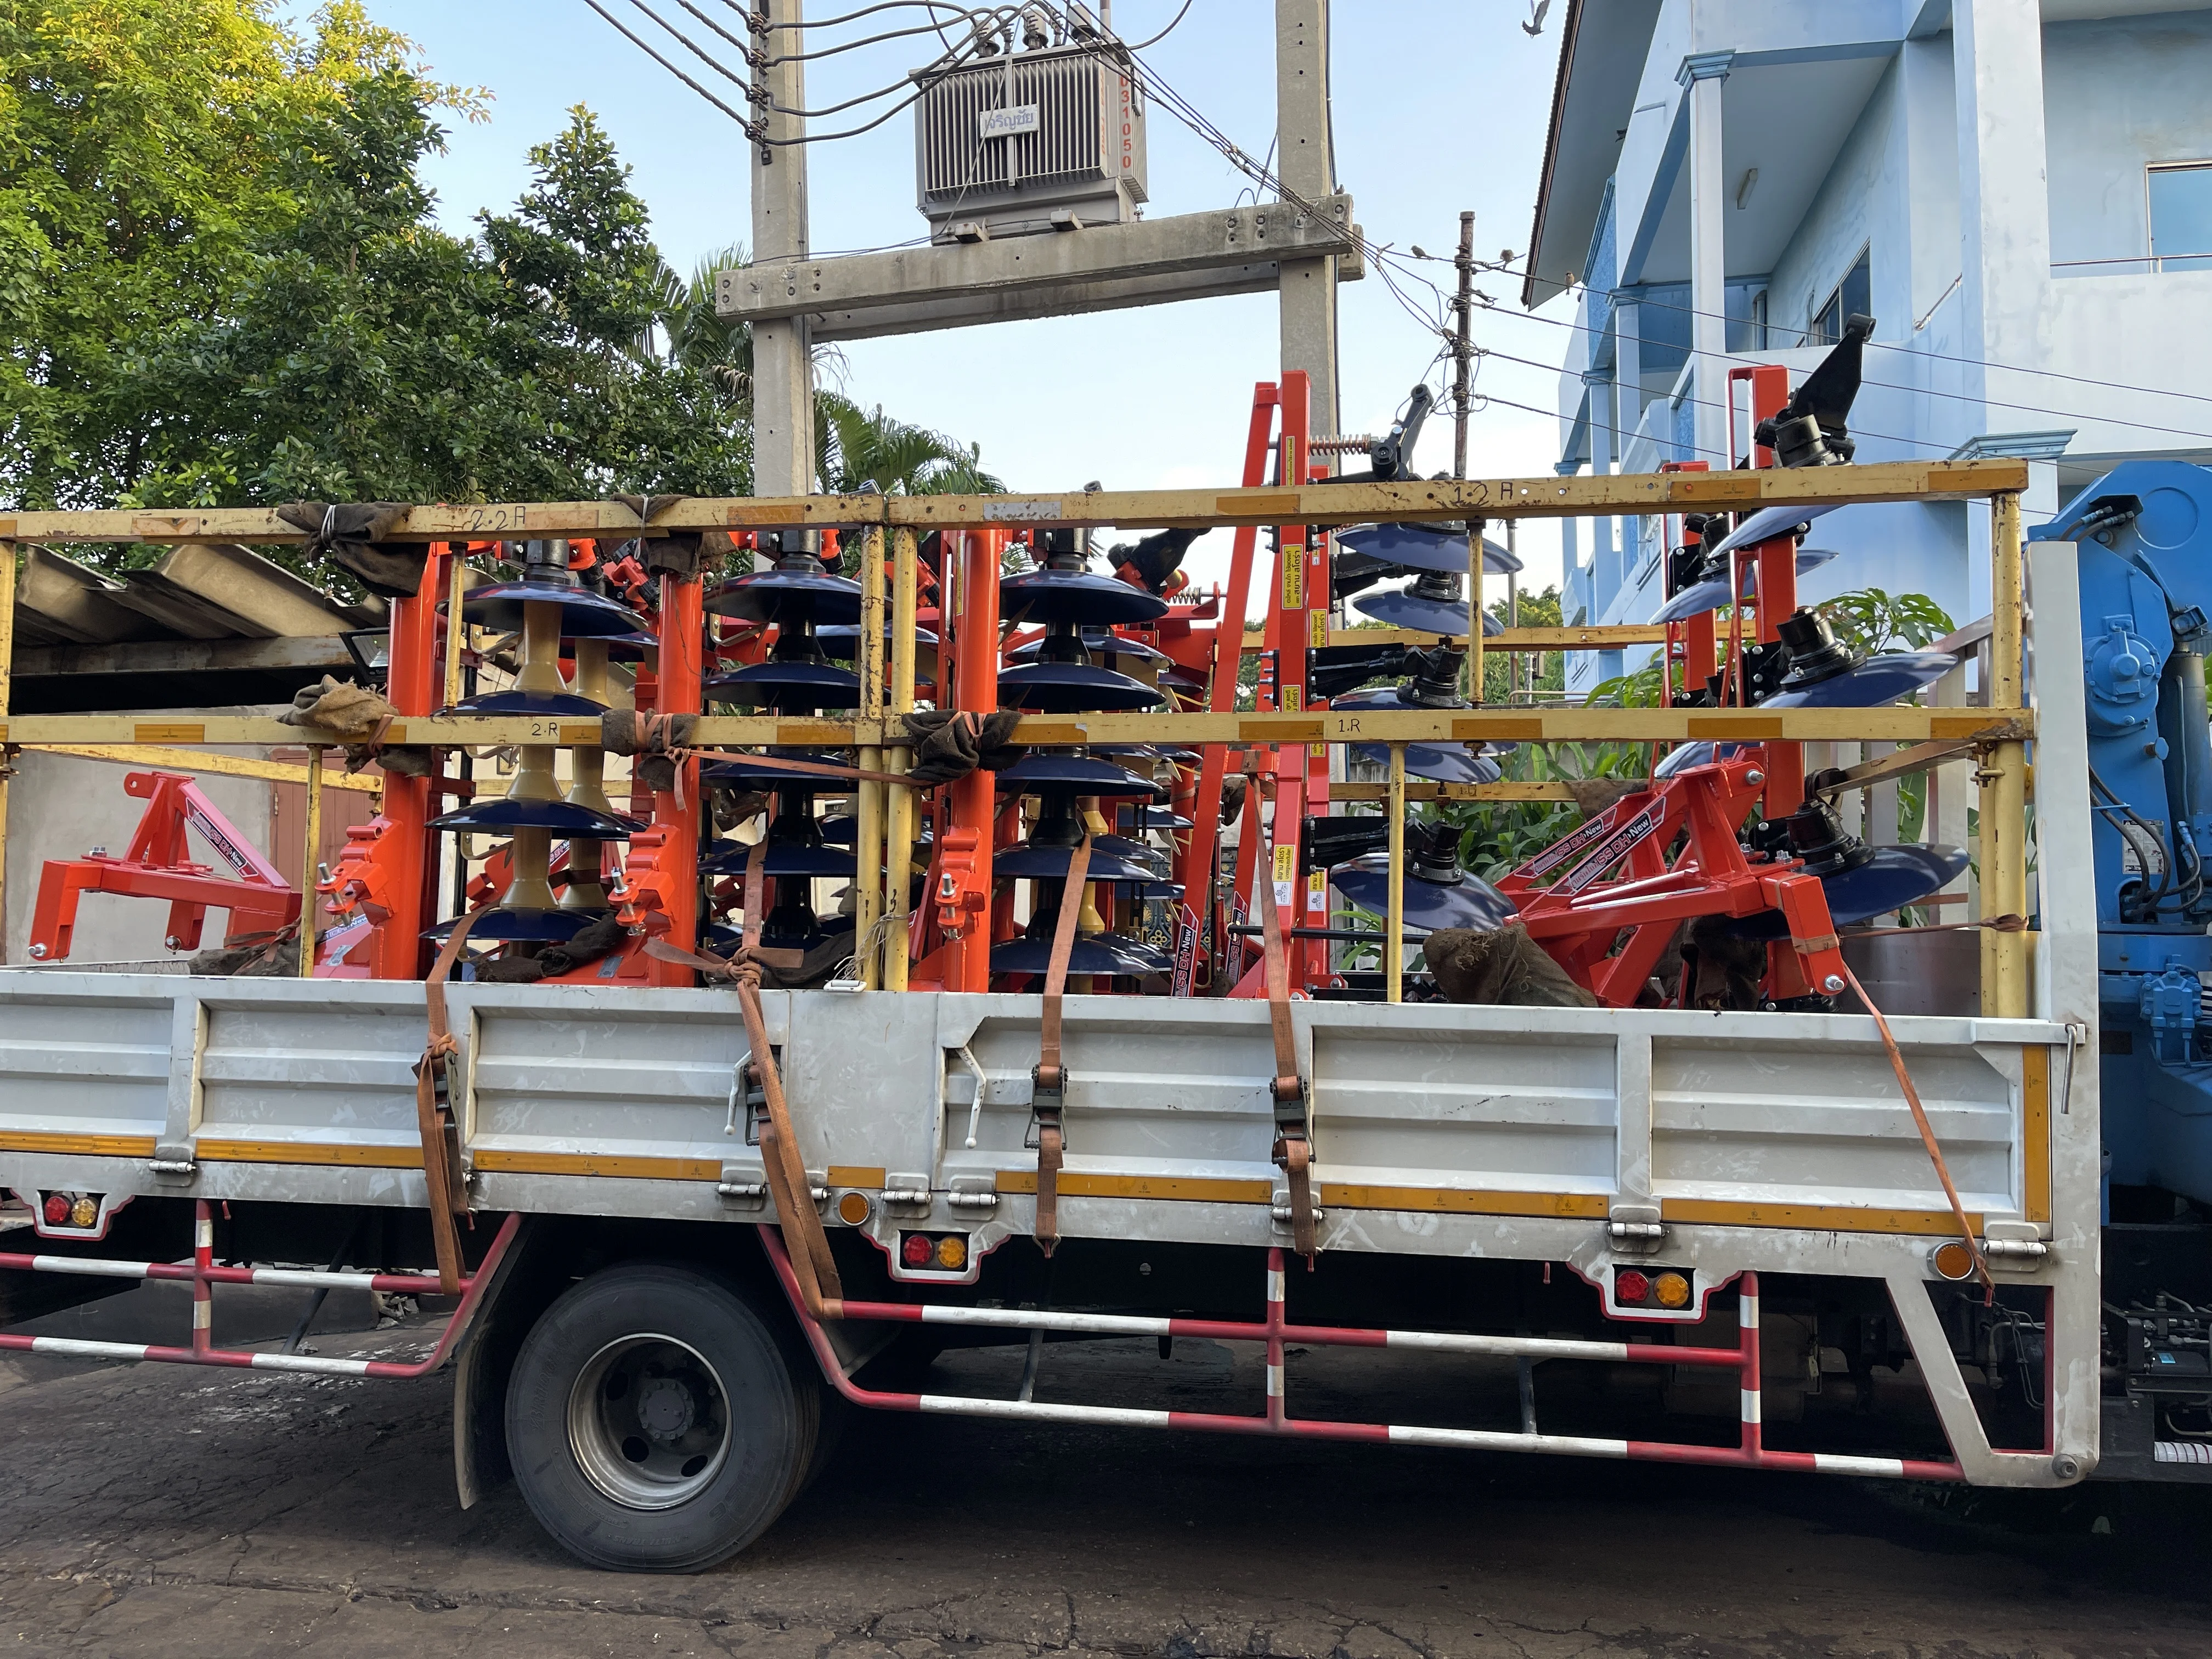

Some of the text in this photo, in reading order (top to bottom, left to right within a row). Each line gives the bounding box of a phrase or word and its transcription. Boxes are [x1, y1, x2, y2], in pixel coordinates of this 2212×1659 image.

[985, 109, 1034, 131] เจริญชัย
[1292, 550, 1300, 573] สโตร่า
[1557, 842, 1571, 856] SS
[1570, 833, 1585, 849] DH
[1585, 823, 1601, 837] New
[1596, 847, 1613, 866] SS
[1611, 833, 1630, 854] DH
[1629, 819, 1649, 837] New
[1177, 929, 1192, 987] SS DH New
